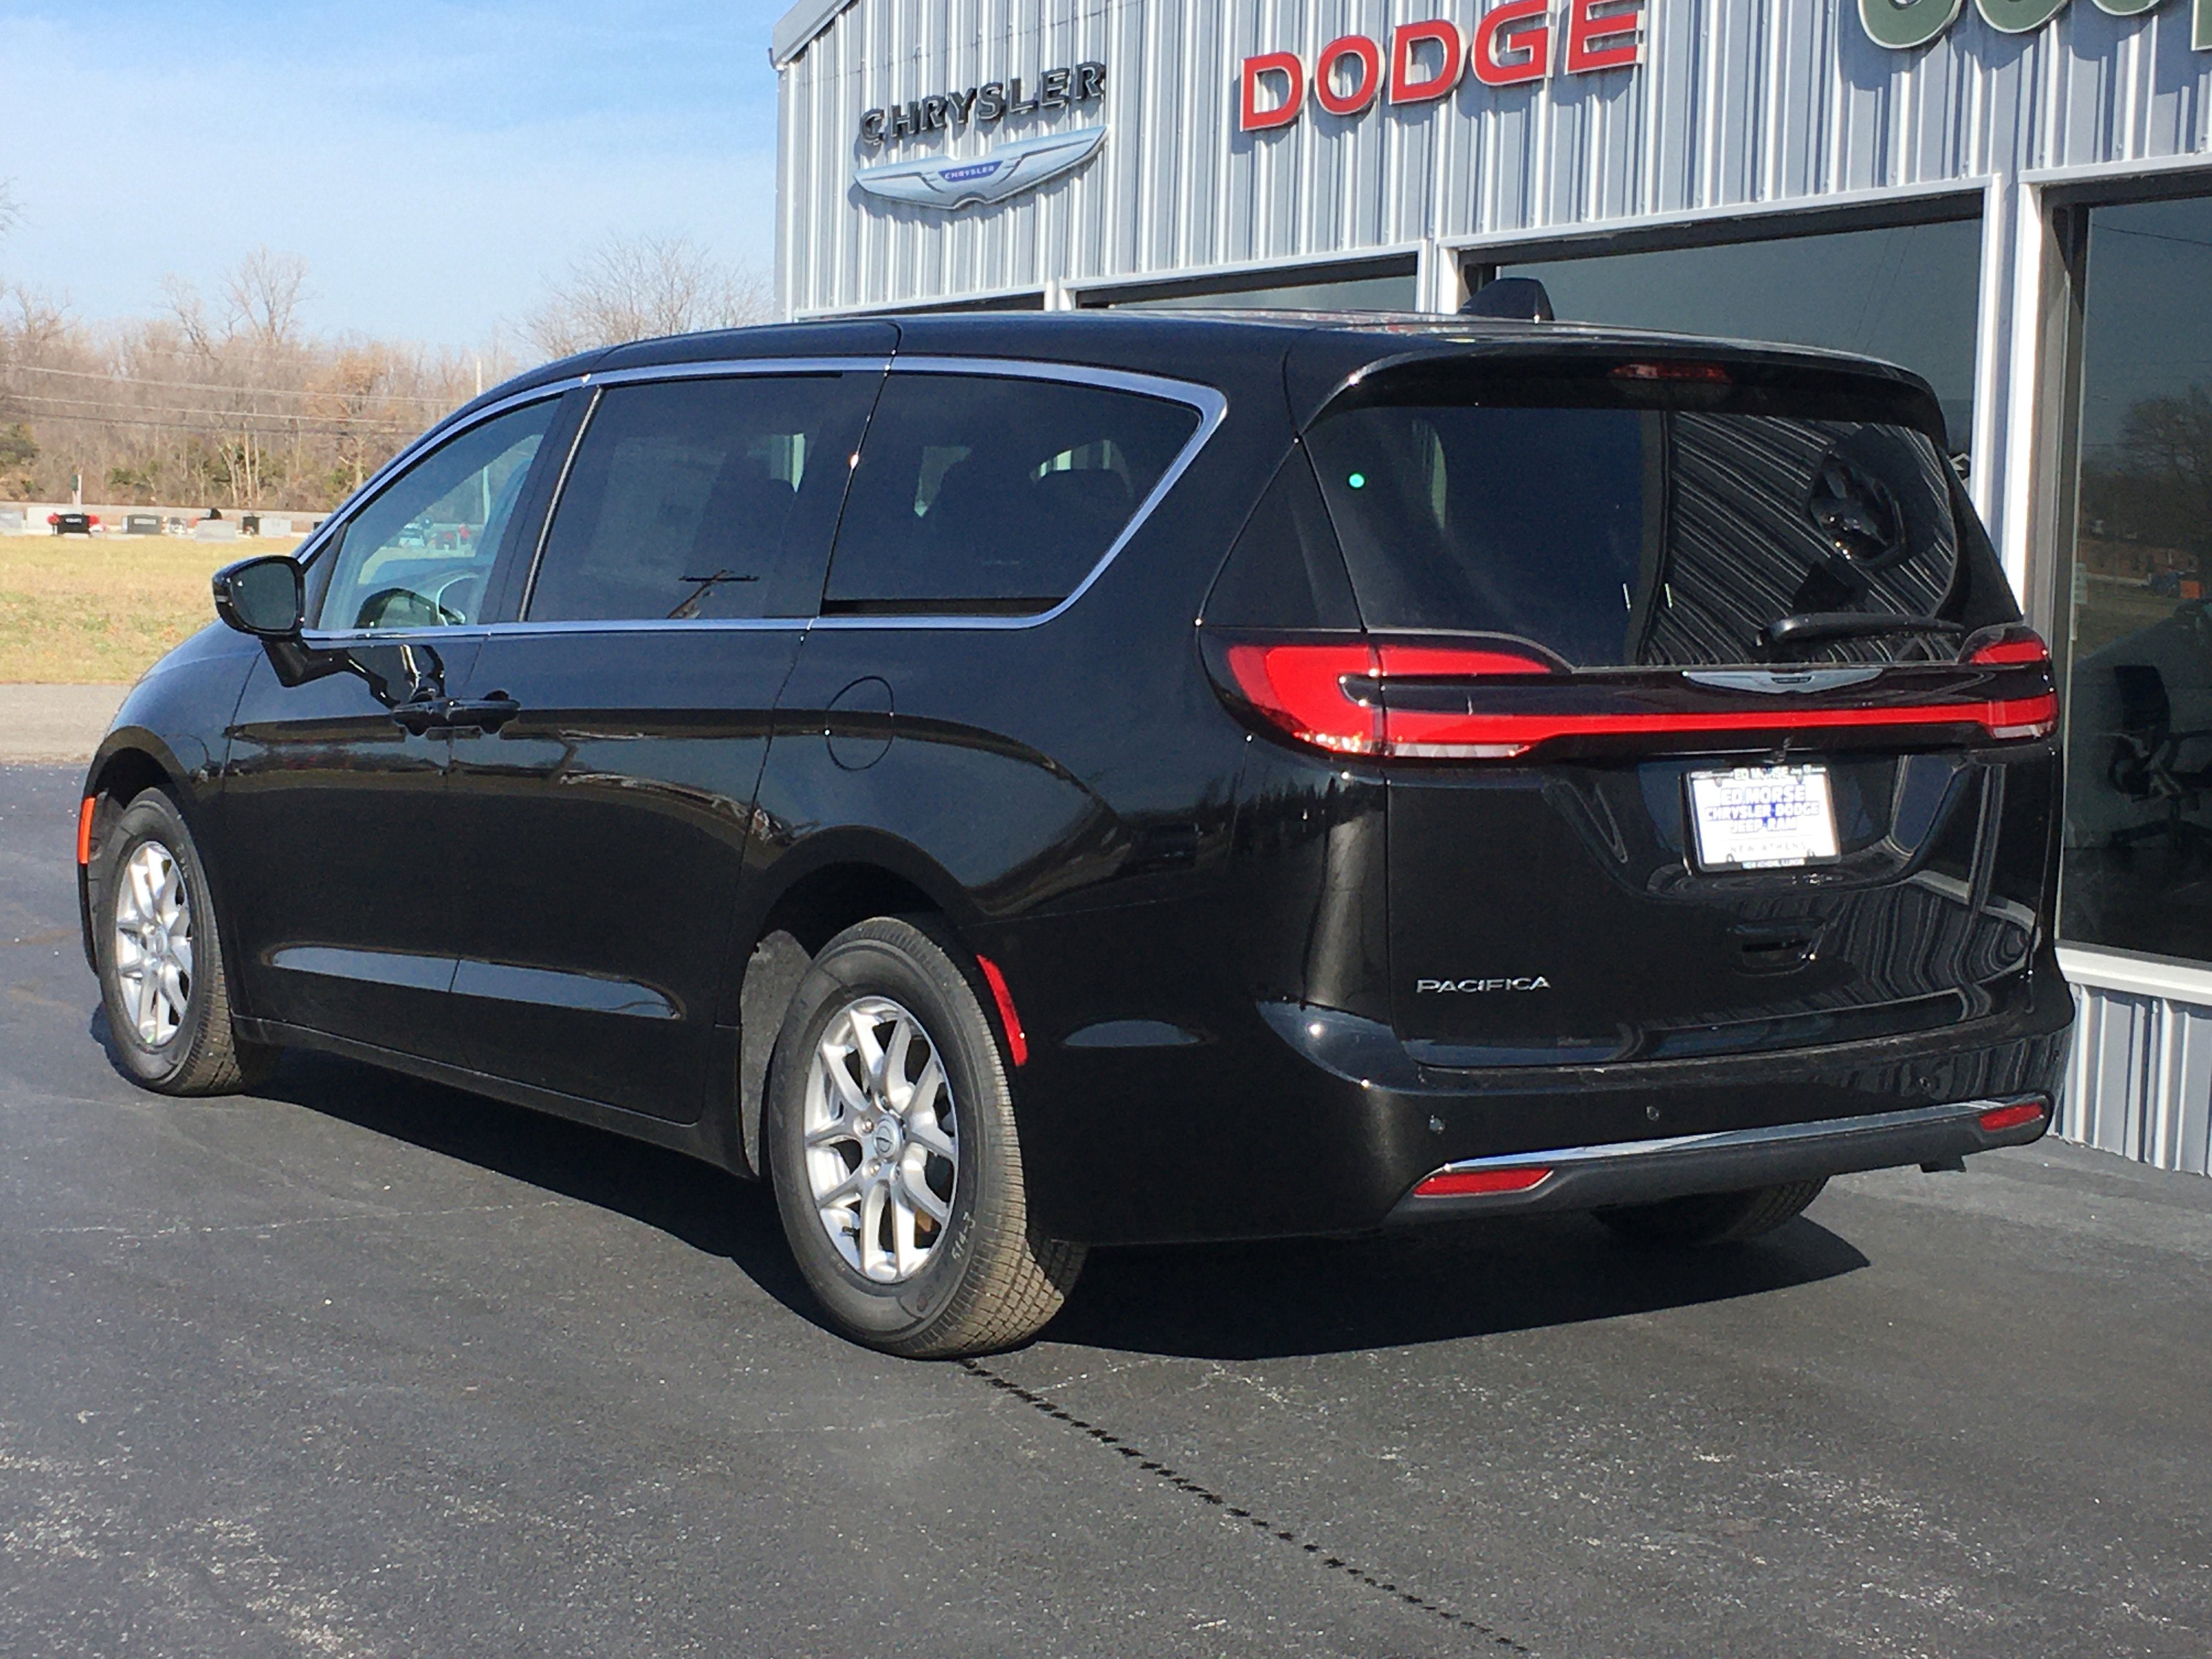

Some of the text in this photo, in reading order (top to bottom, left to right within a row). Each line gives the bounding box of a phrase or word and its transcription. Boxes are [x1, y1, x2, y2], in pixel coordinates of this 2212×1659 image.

[1240, 0, 1645, 132] DODGE
[860, 61, 1106, 145] CHRYSLER
[945, 166, 994, 179] CHRYSLER
[1721, 785, 1806, 805] ED MORSE
[1705, 801, 1819, 821] CHRYSLER DODGE
[1730, 816, 1797, 833] JEEP RAM
[1417, 976, 1550, 993] PACIFICA
